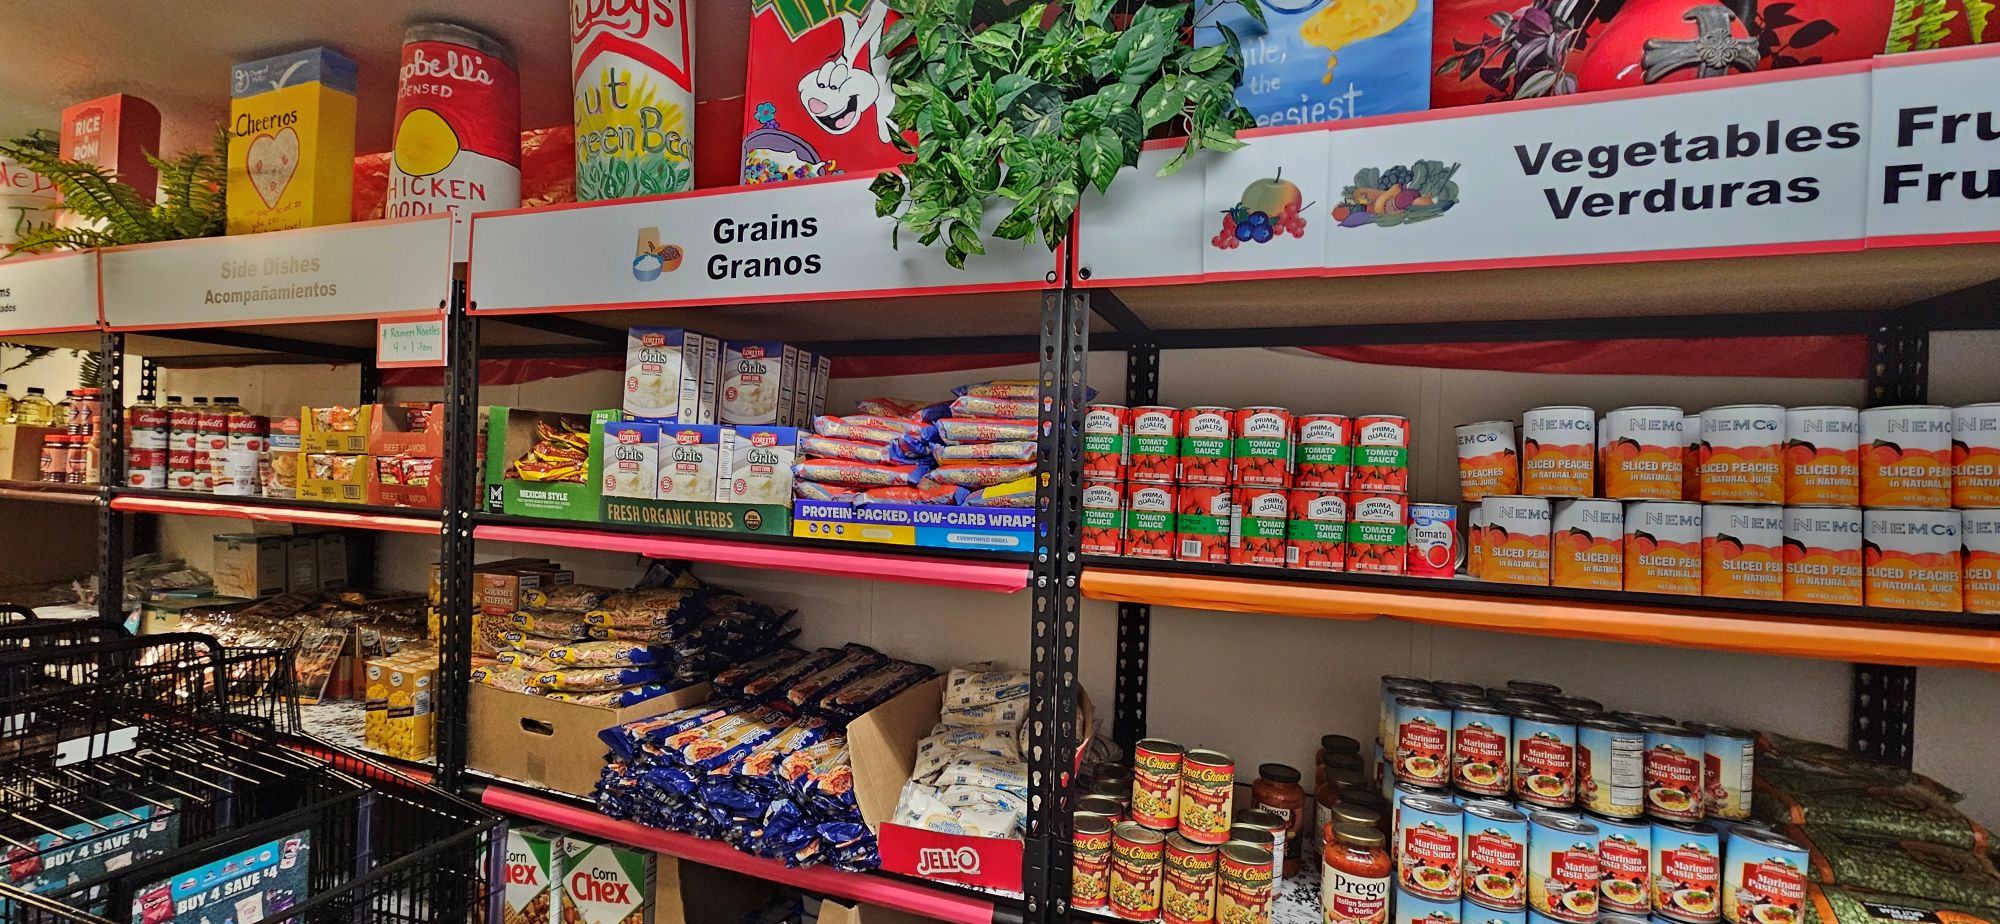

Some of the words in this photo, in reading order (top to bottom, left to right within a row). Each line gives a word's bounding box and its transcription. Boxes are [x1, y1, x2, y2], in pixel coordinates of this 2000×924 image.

[1242, 36, 1286, 68] ile,
[400, 84, 452, 98] DENSED
[1251, 74, 1280, 95] the
[1256, 82, 1362, 126] eesiest
[75, 116, 100, 136] RICE
[237, 111, 297, 136] Cheerios
[1898, 106, 2000, 148] Fru
[578, 127, 634, 157] reen
[639, 107, 693, 159] Bea
[74, 142, 98, 160] RONI
[1514, 120, 1860, 179] Vegetables
[389, 177, 485, 200] HICKEN
[1883, 164, 2000, 204] Fru
[1543, 176, 1820, 220] Verduras
[714, 213, 818, 244] Grains
[220, 260, 257, 280] Side
[263, 255, 320, 276] Dishes
[707, 251, 821, 280] Granos
[205, 282, 336, 306] Acompañamientos
[391, 328, 414, 338] Ramen
[394, 342, 398, 352] 4
[638, 348, 667, 363] Grits
[1372, 426, 1395, 434] PRIMA
[619, 434, 640, 443] LORETTA
[676, 434, 700, 443] LORETTA
[752, 435, 776, 445] LORETTA
[1193, 440, 1223, 448] TOMATO
[1249, 440, 1280, 448] TOMATO
[615, 446, 643, 461] Grits
[672, 447, 702, 462] Grits
[747, 449, 778, 464] Grits
[1195, 447, 1221, 455] SAUCE
[1527, 460, 1555, 469] SLICED
[1701, 463, 1728, 473] SLICED
[1732, 463, 1779, 473] PEACHES
[1468, 468, 1504, 477] PEACHES
[520, 490, 547, 499] MEXICAN
[548, 492, 568, 500] STYLE
[608, 504, 639, 521] FRESH
[643, 506, 691, 526] ORGANIC
[695, 511, 734, 529] HERBS
[803, 506, 911, 524] PROTEIN-PACKED,
[914, 511, 986, 525] LOW-CARB
[1412, 508, 1450, 518] CONDENSED
[1314, 524, 1343, 532] TOMATO
[1360, 526, 1395, 534] TOMATO
[1414, 528, 1446, 538] Tomato
[1317, 532, 1341, 540] SAUCE
[1866, 567, 1904, 579] SLICED
[1909, 569, 1958, 582] PEACHES
[485, 588, 513, 596] GOURMET
[1882, 582, 1926, 592] NATURAL
[484, 596, 513, 605] STUFFING
[1402, 738, 1421, 748] Pasta
[1422, 741, 1444, 750] Sauce
[1407, 732, 1439, 743] Marinara
[1135, 754, 1147, 765] reat
[1147, 756, 1176, 770] Choice
[1650, 761, 1691, 775] Marinara
[1201, 769, 1230, 782] Choice
[1645, 767, 1668, 778] Pasta
[1670, 771, 1697, 782] Sauce
[45, 850, 75, 870] BUY
[78, 845, 89, 857] 4
[94, 833, 130, 854] SAVE
[133, 828, 148, 840] $4
[1409, 844, 1431, 856] Pasta
[1433, 849, 1455, 859] Sauce
[1414, 838, 1451, 851] Marinara
[1129, 847, 1159, 860] Choice
[1471, 850, 1494, 864] Pasta
[1497, 857, 1521, 867] Sauce
[1478, 846, 1515, 859] Marinara
[921, 850, 976, 871] JELL-O
[592, 867, 617, 881] Corn
[1220, 859, 1243, 878] Great
[1243, 868, 1271, 880] Choice
[177, 893, 206, 915] BUY
[211, 888, 220, 900] 4
[224, 873, 260, 895] SAVE
[264, 865, 278, 879] $4
[572, 872, 630, 904] Chex
[1335, 874, 1385, 900] Prego
[1337, 897, 1357, 907] Italian
[1358, 900, 1382, 909] Sausage
[1354, 906, 1373, 915] Garlic
